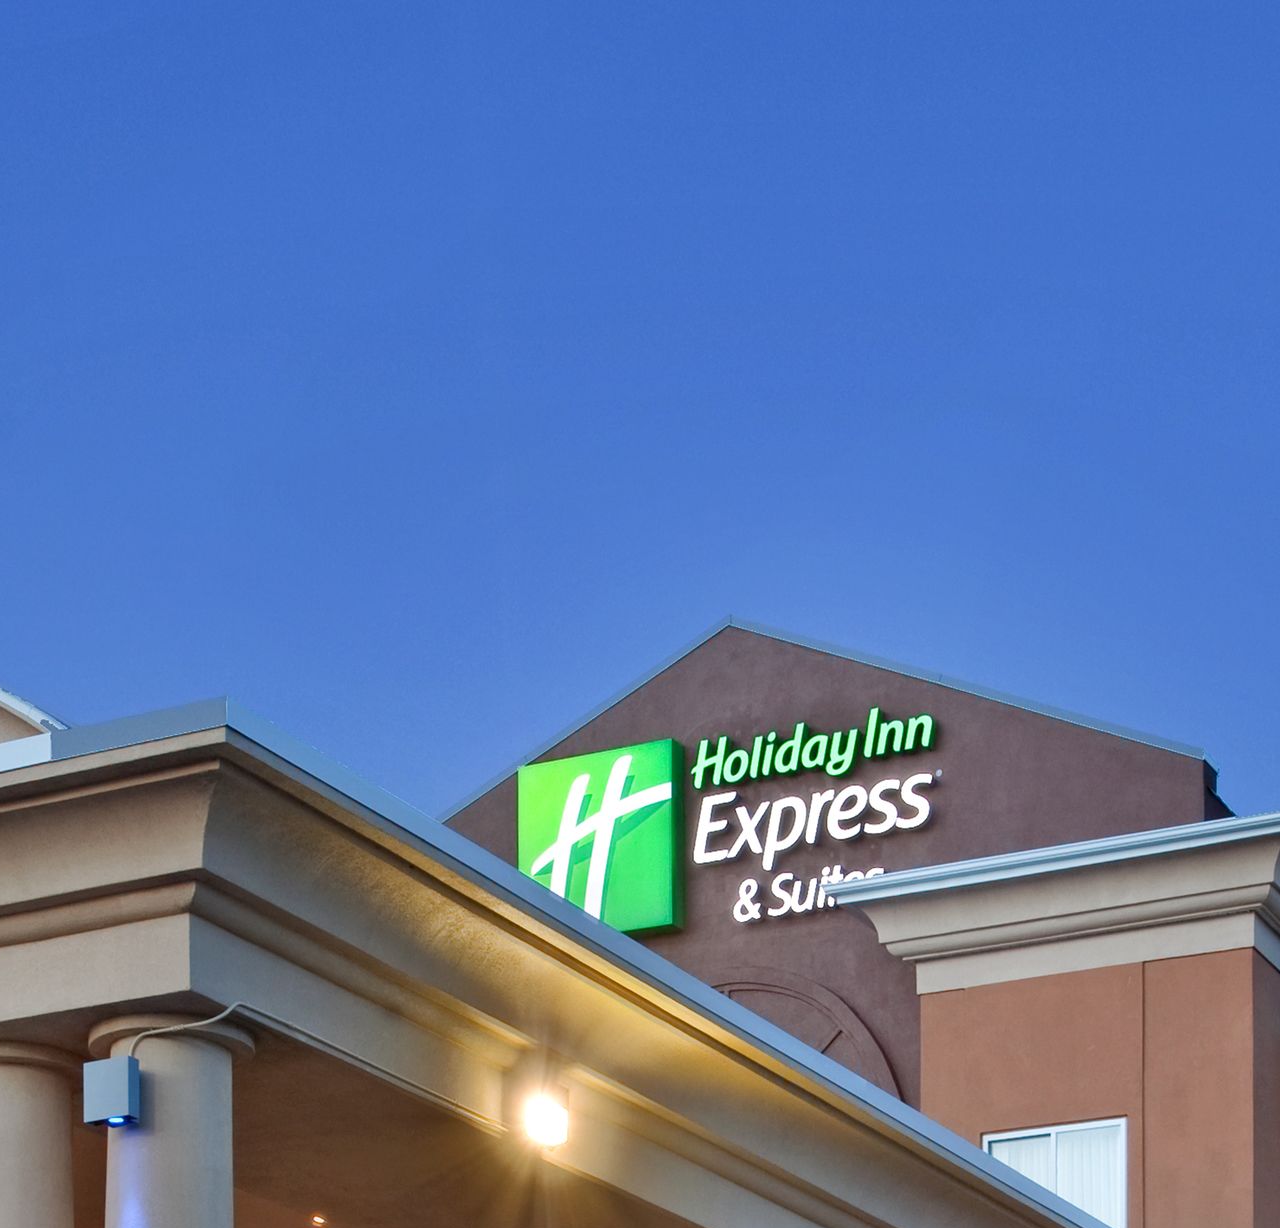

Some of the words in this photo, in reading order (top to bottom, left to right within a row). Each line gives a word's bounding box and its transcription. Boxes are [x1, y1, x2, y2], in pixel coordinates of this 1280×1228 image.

[691, 722, 857, 789] Holiday
[863, 706, 934, 758] Inn
[693, 773, 933, 871] Express
[733, 878, 761, 923] &
[768, 864, 885, 917] Suit
